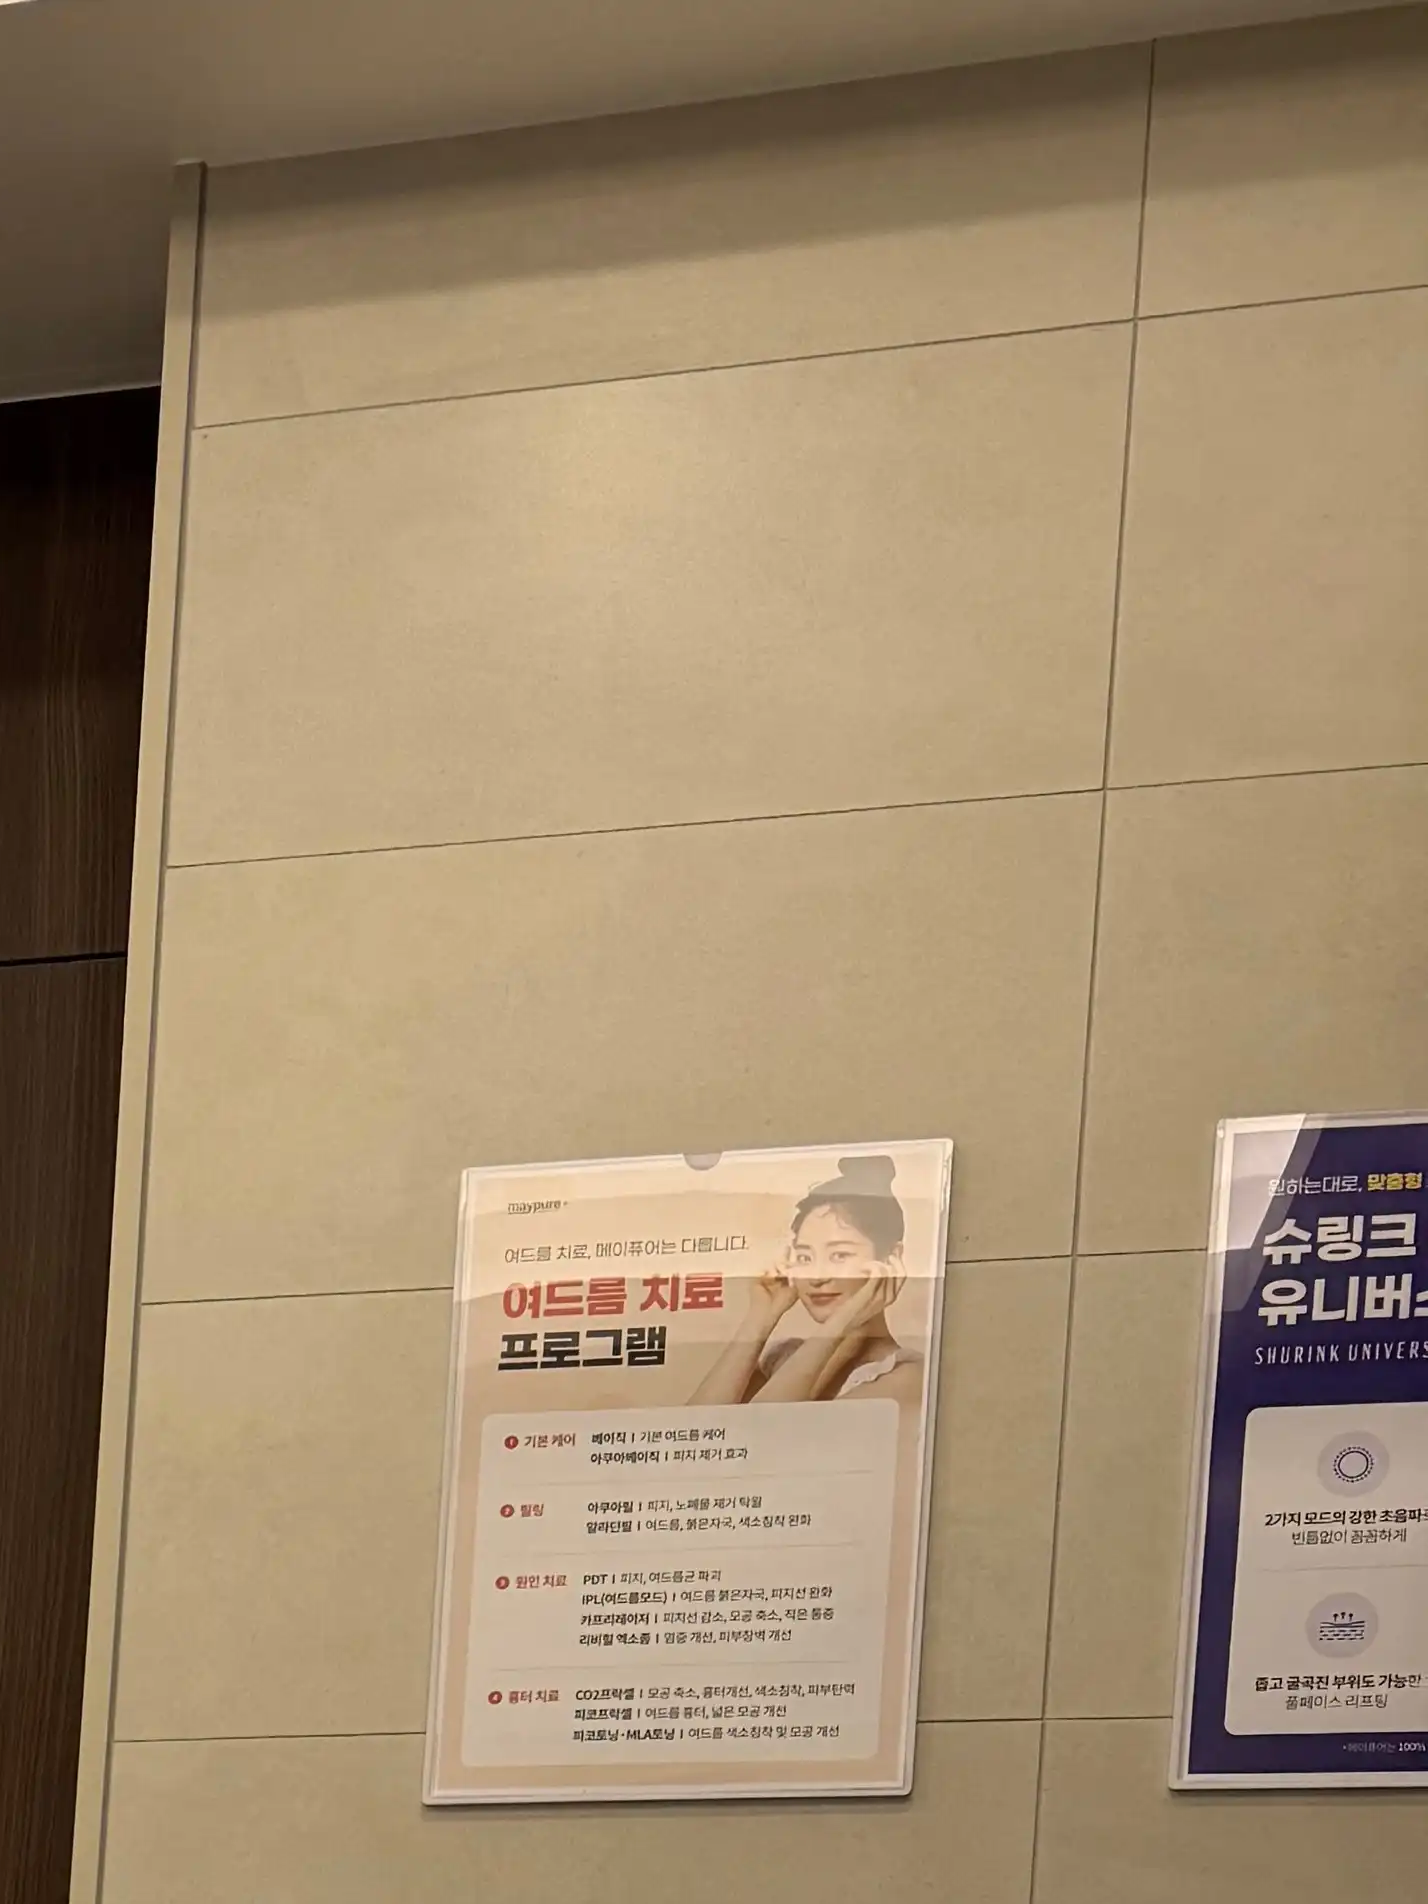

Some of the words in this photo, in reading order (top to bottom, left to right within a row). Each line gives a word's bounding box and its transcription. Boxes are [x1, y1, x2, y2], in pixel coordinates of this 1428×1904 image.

[1268, 1176, 1363, 1197] 원하는대로,
[1367, 1172, 1422, 1191] 맞춤형
[1262, 1212, 1417, 1265] 슈링크
[504, 1246, 551, 1264] 여드름
[556, 1245, 591, 1260] 치료,
[596, 1239, 677, 1259] 메이퓨어는
[681, 1235, 750, 1254] 다릅니다.
[503, 1276, 628, 1319] 여드름
[639, 1272, 724, 1312] 치료
[498, 1326, 667, 1371] 프로그램
[1254, 1345, 1340, 1365] SHURINK
[524, 1435, 548, 1448] 기본
[551, 1433, 576, 1447] 케어
[591, 1432, 626, 1445] 베이직
[640, 1431, 662, 1443] 기본
[665, 1429, 699, 1442] 여드름
[703, 1428, 726, 1441] 케어
[590, 1451, 659, 1465] 아쿠아베이직
[673, 1449, 696, 1462] 피지
[698, 1448, 722, 1461] 제거
[724, 1447, 748, 1460] 효과
[587, 1501, 633, 1514] 아쿠아필
[647, 1500, 673, 1512] 피지,
[586, 1520, 632, 1534] 알라딘필
[645, 1518, 684, 1532] 여드름,
[1265, 1512, 1302, 1527] 2가지
[1304, 1510, 1346, 1526] 모드의
[1349, 1509, 1377, 1525] 강한
[1292, 1530, 1348, 1545] 빈틈없이
[1350, 1528, 1407, 1544] 꼼꼼하게
[516, 1575, 540, 1589] 원인
[542, 1575, 568, 1588] 치료
[583, 1574, 608, 1585] PDT
[620, 1573, 646, 1585] 피지,
[698, 1570, 722, 1582] 파괴
[581, 1591, 667, 1606] IPL(여드름모드)
[680, 1591, 715, 1603] 여드름
[771, 1587, 806, 1600] 피지선
[580, 1613, 649, 1627] 카프리레이저
[663, 1611, 698, 1624] 피지선
[701, 1610, 727, 1623] 감소,
[730, 1610, 752, 1622] 모공
[579, 1633, 614, 1647] 리비힐
[616, 1632, 651, 1646] 엑소좀
[690, 1631, 717, 1644] 개선,
[768, 1629, 792, 1641] 개선
[1255, 1676, 1284, 1692] 좁고
[1286, 1675, 1329, 1691] 굴곡진
[1332, 1675, 1376, 1690] 부위도
[1379, 1674, 1422, 1689] 가능한
[509, 1690, 533, 1704] 흉터
[535, 1690, 560, 1703] 치료
[575, 1688, 634, 1701] CO2프락셀
[648, 1687, 670, 1699] 모공
[755, 1685, 805, 1698] 색소침착,
[807, 1683, 855, 1696] 피부탄력
[1285, 1695, 1342, 1710] 풀페이스
[1345, 1693, 1388, 1708] 리프팅
[574, 1708, 632, 1721] 피코프락셀
[645, 1706, 680, 1720] 여드름
[683, 1706, 709, 1719] 흉터,
[737, 1705, 760, 1718] 모공
[763, 1705, 787, 1718] 개선
[688, 1726, 723, 1740] 여드름
[726, 1726, 773, 1739] 색소침착
[776, 1726, 788, 1739] 및
[790, 1725, 813, 1738] 모공
[816, 1724, 840, 1738] 개선
